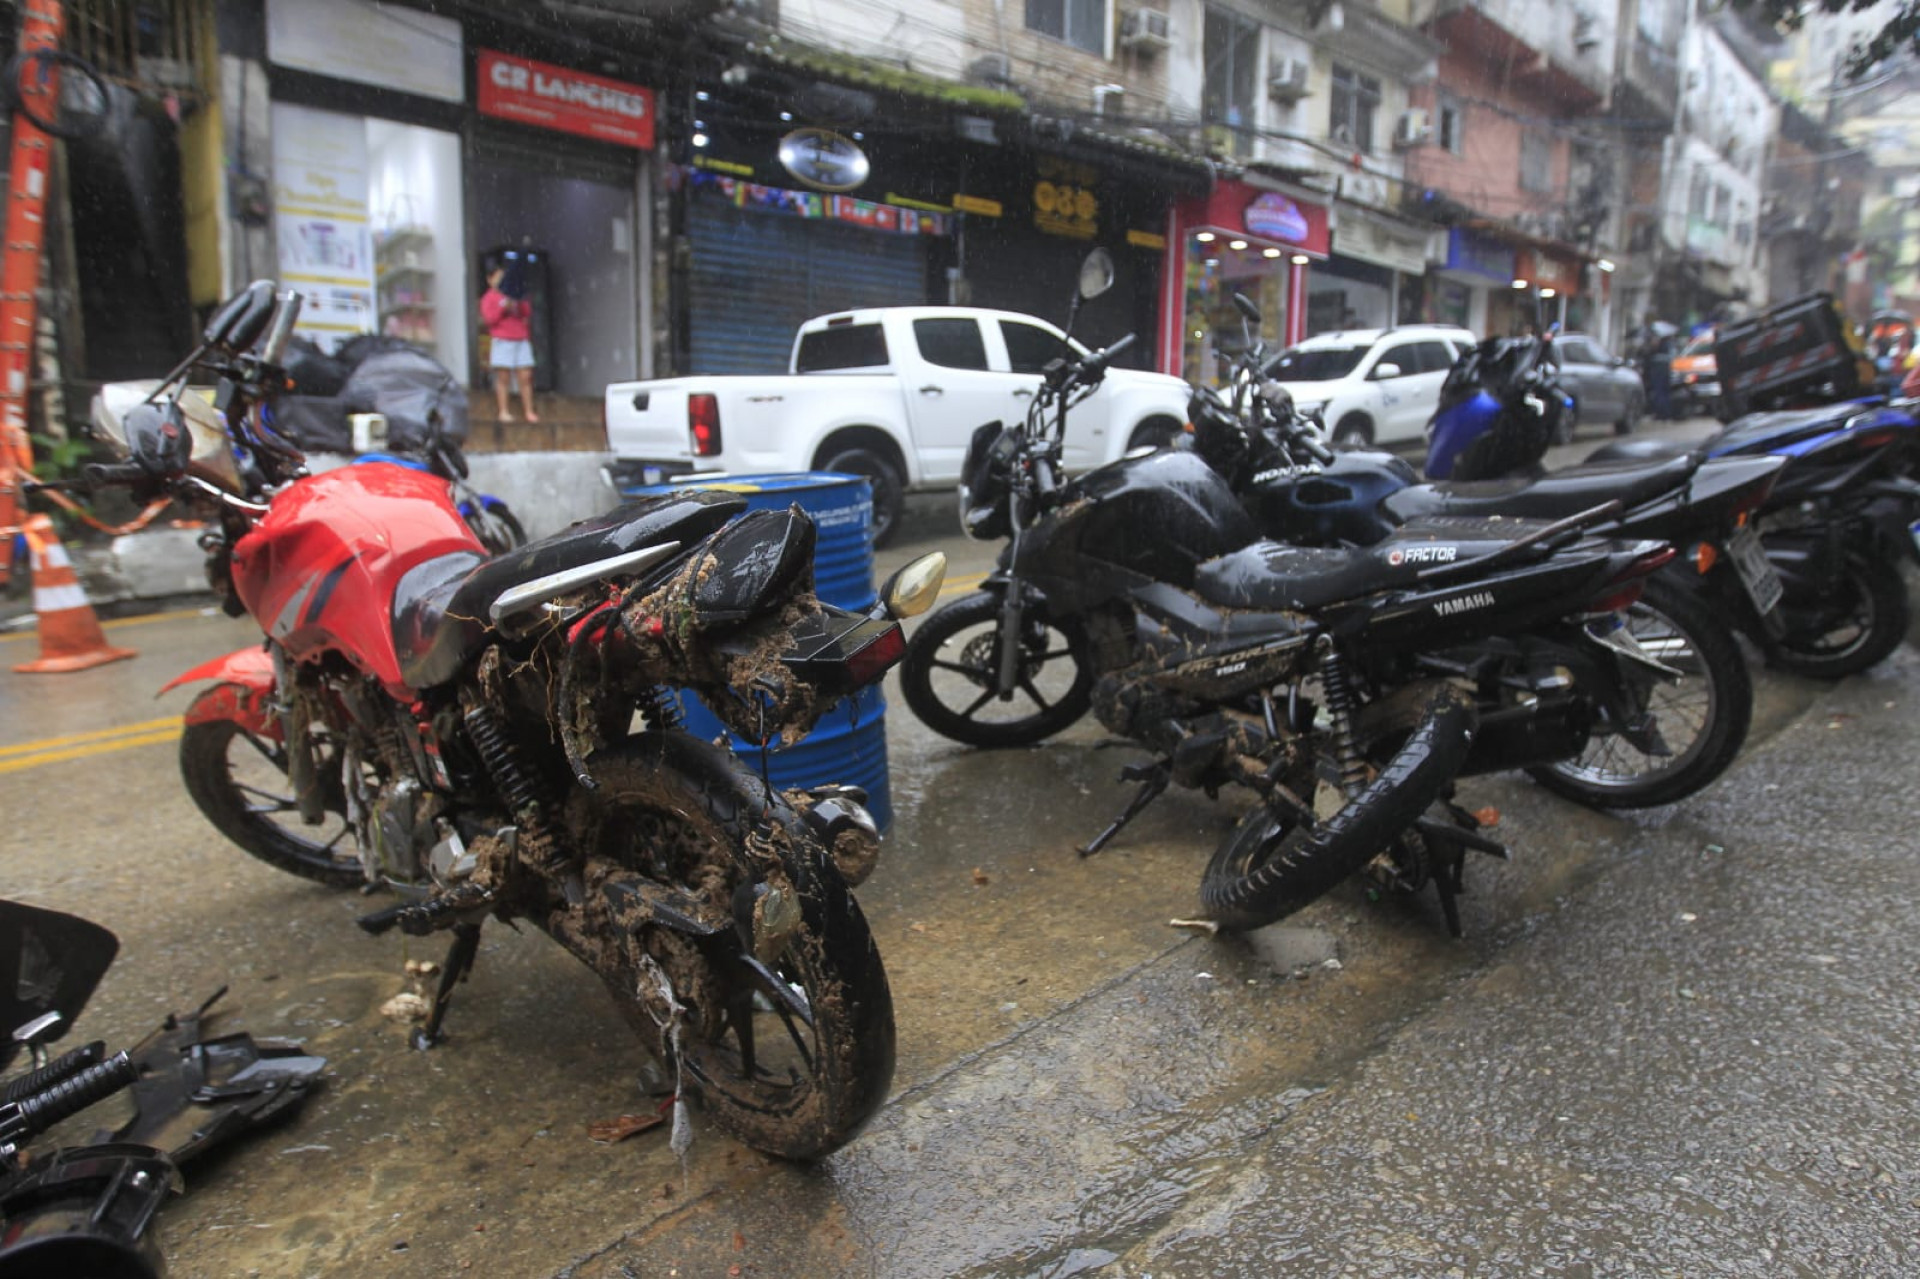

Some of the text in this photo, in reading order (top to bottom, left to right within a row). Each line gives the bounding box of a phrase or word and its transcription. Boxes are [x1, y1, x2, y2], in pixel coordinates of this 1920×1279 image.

[490, 61, 529, 91] CR
[533, 72, 645, 119] LANCHES
[1252, 464, 1321, 483] HONDA
[1404, 547, 1457, 563] FACTOR
[1433, 590, 1496, 617] YAMAHA
[1216, 661, 1247, 677] 150
